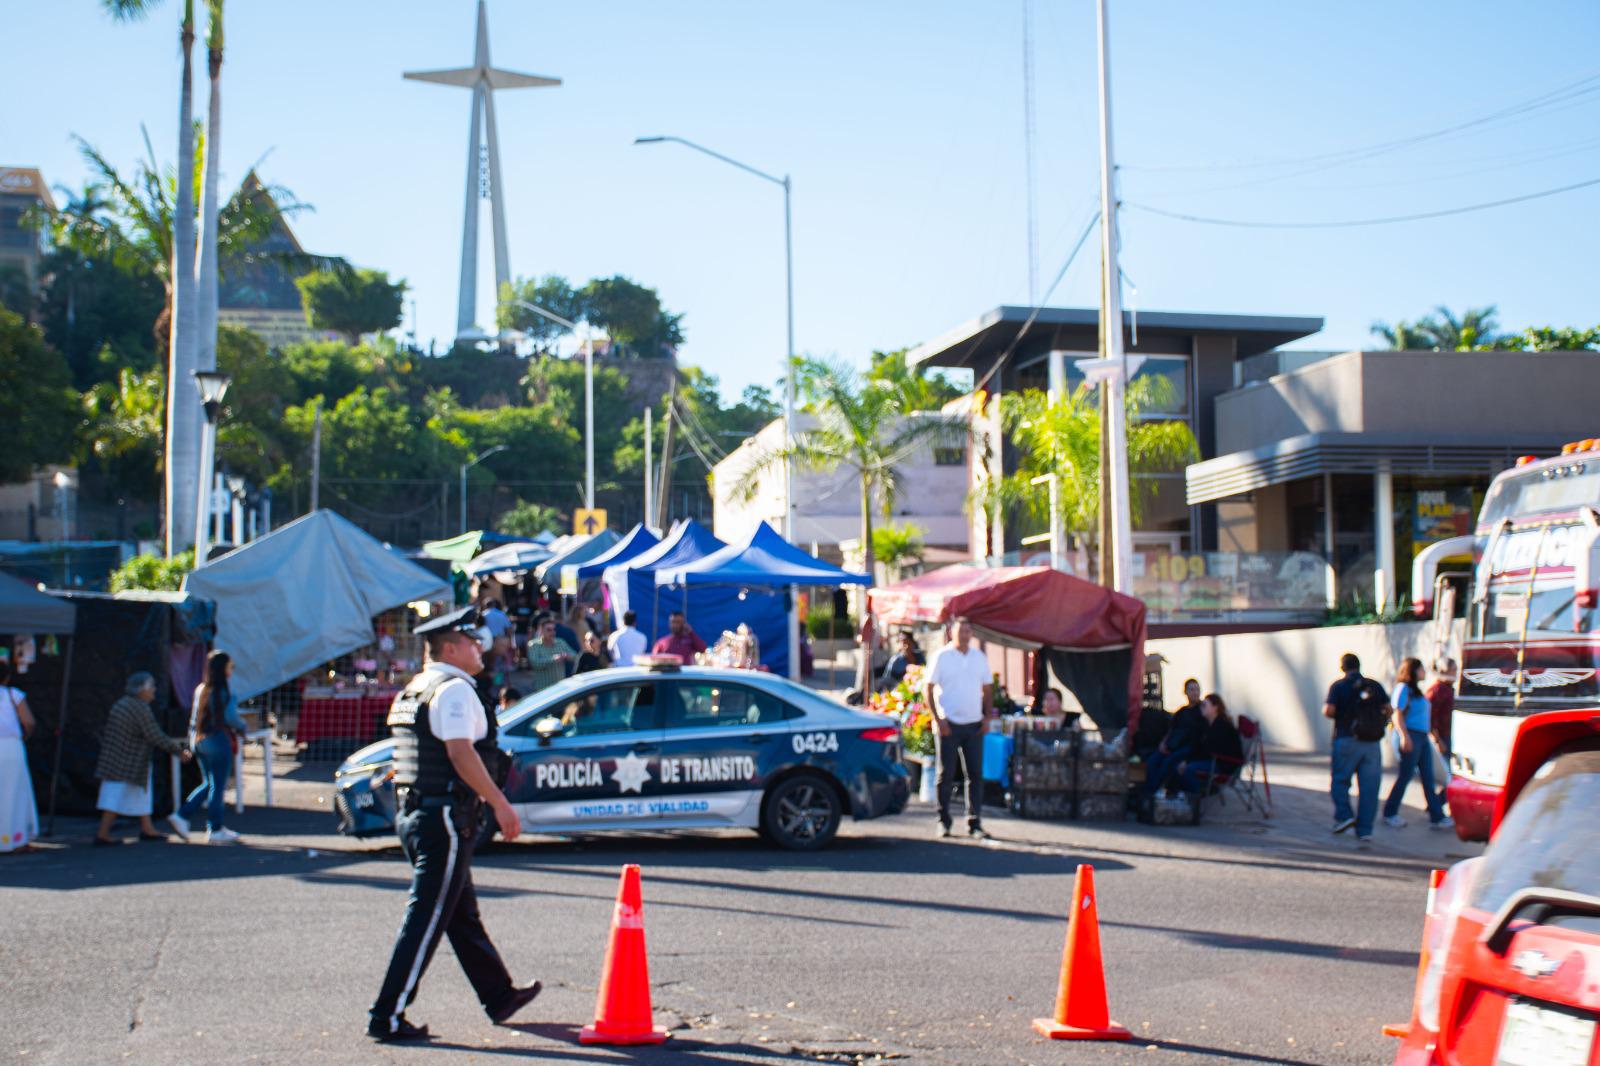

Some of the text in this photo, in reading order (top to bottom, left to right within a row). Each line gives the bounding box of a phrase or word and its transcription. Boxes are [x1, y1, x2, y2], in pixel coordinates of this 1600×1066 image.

[791, 732, 840, 754] 0424
[535, 756, 755, 789] POLICÍA DE TRANSITO
[573, 800, 709, 817] UNIDAD DE VIALIDAD
